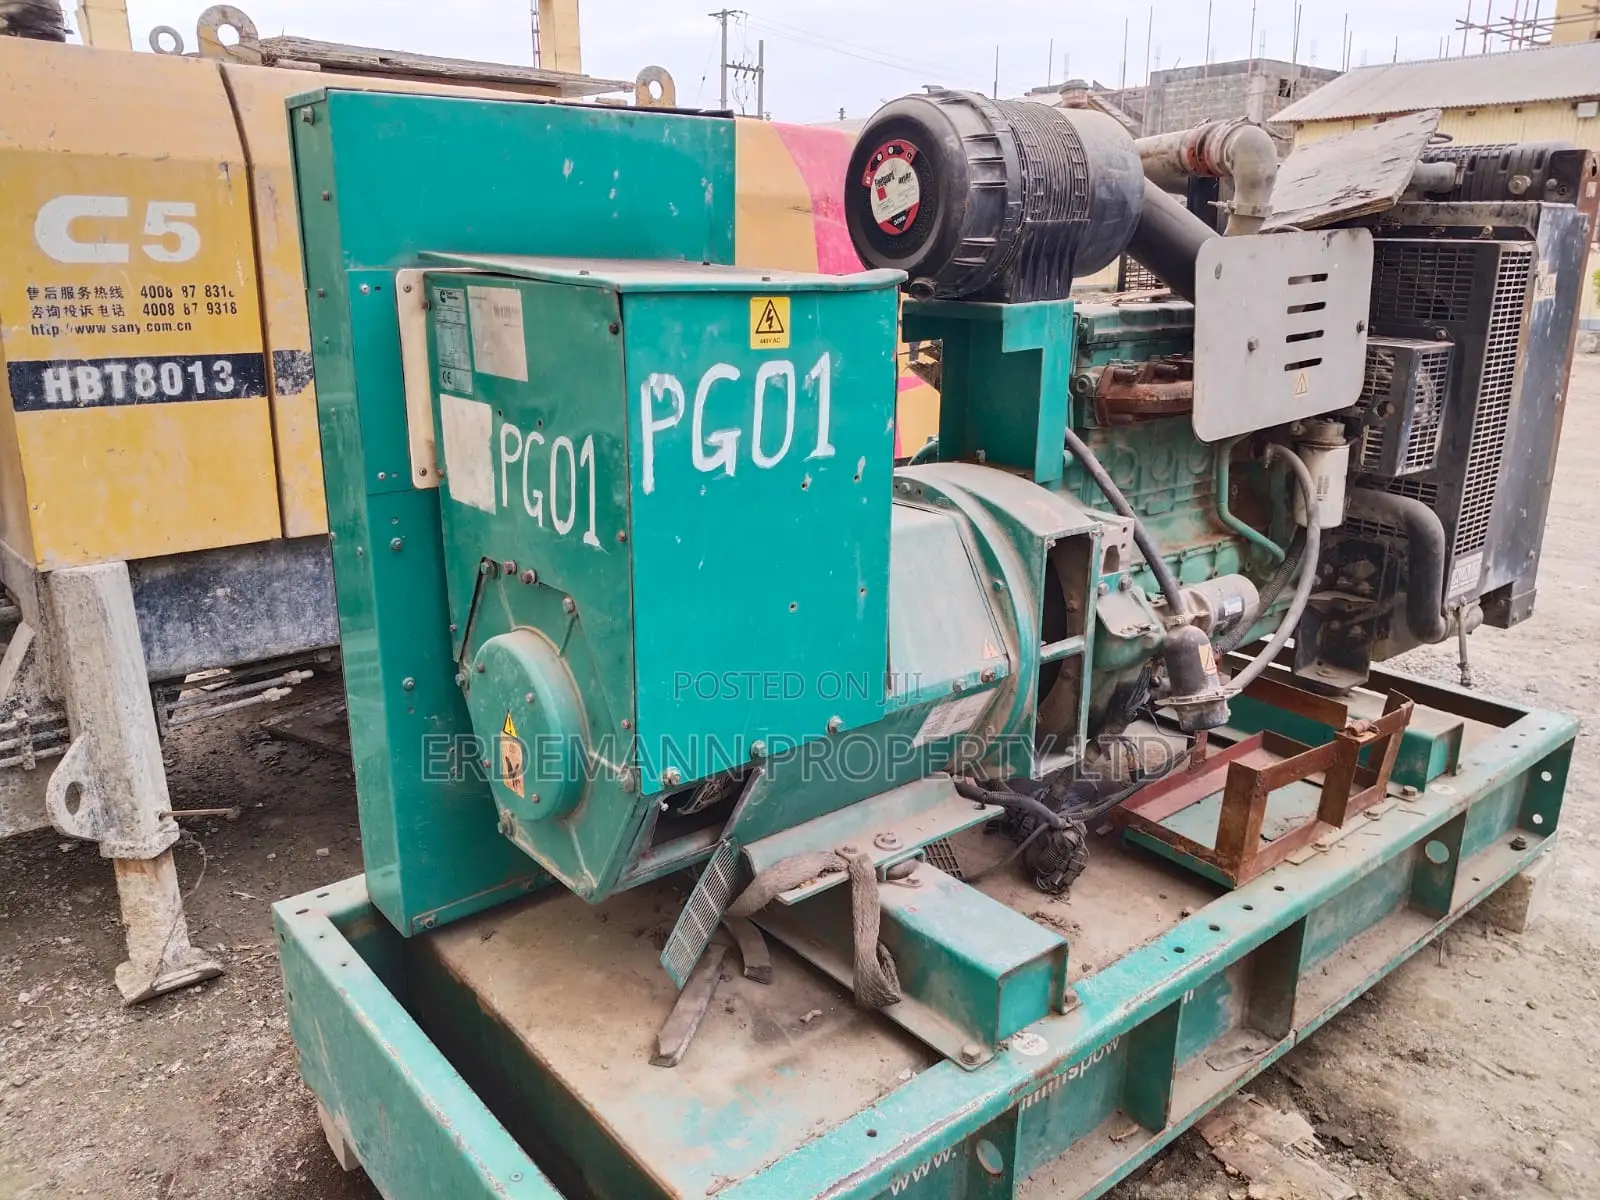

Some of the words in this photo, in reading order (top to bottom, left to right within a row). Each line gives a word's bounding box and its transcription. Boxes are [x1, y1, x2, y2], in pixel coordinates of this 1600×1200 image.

[140, 285, 173, 299] 4008
[181, 285, 196, 299] 87
[143, 302, 175, 316] 4008
[42, 360, 236, 403] HBT8013
[640, 352, 836, 496] PG01
[500, 422, 601, 546] PG01
